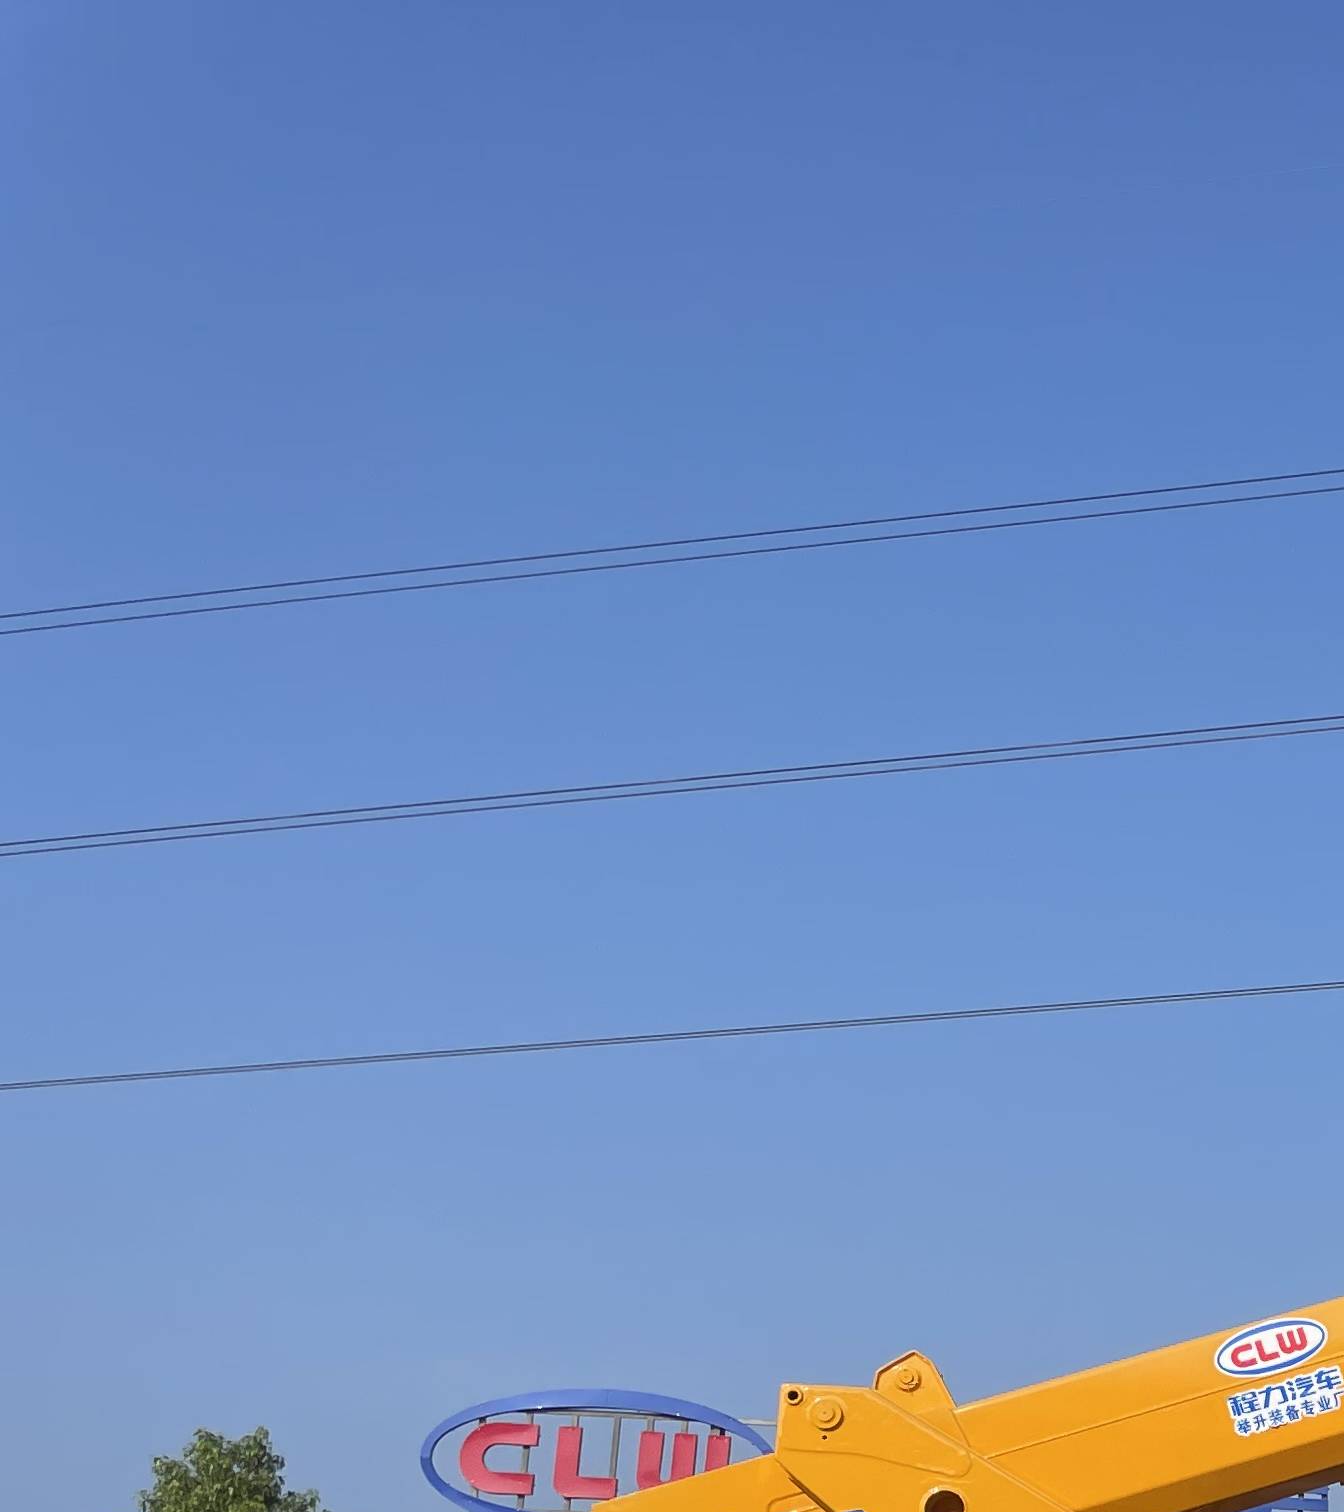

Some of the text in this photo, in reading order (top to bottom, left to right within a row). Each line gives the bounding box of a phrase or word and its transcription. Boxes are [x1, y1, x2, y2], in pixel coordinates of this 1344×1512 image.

[1231, 1327, 1308, 1368] CLW
[1228, 1369, 1342, 1416] 程力汽车
[1237, 1390, 1344, 1434] 举升装备专业厂
[459, 1422, 731, 1500] CLW
